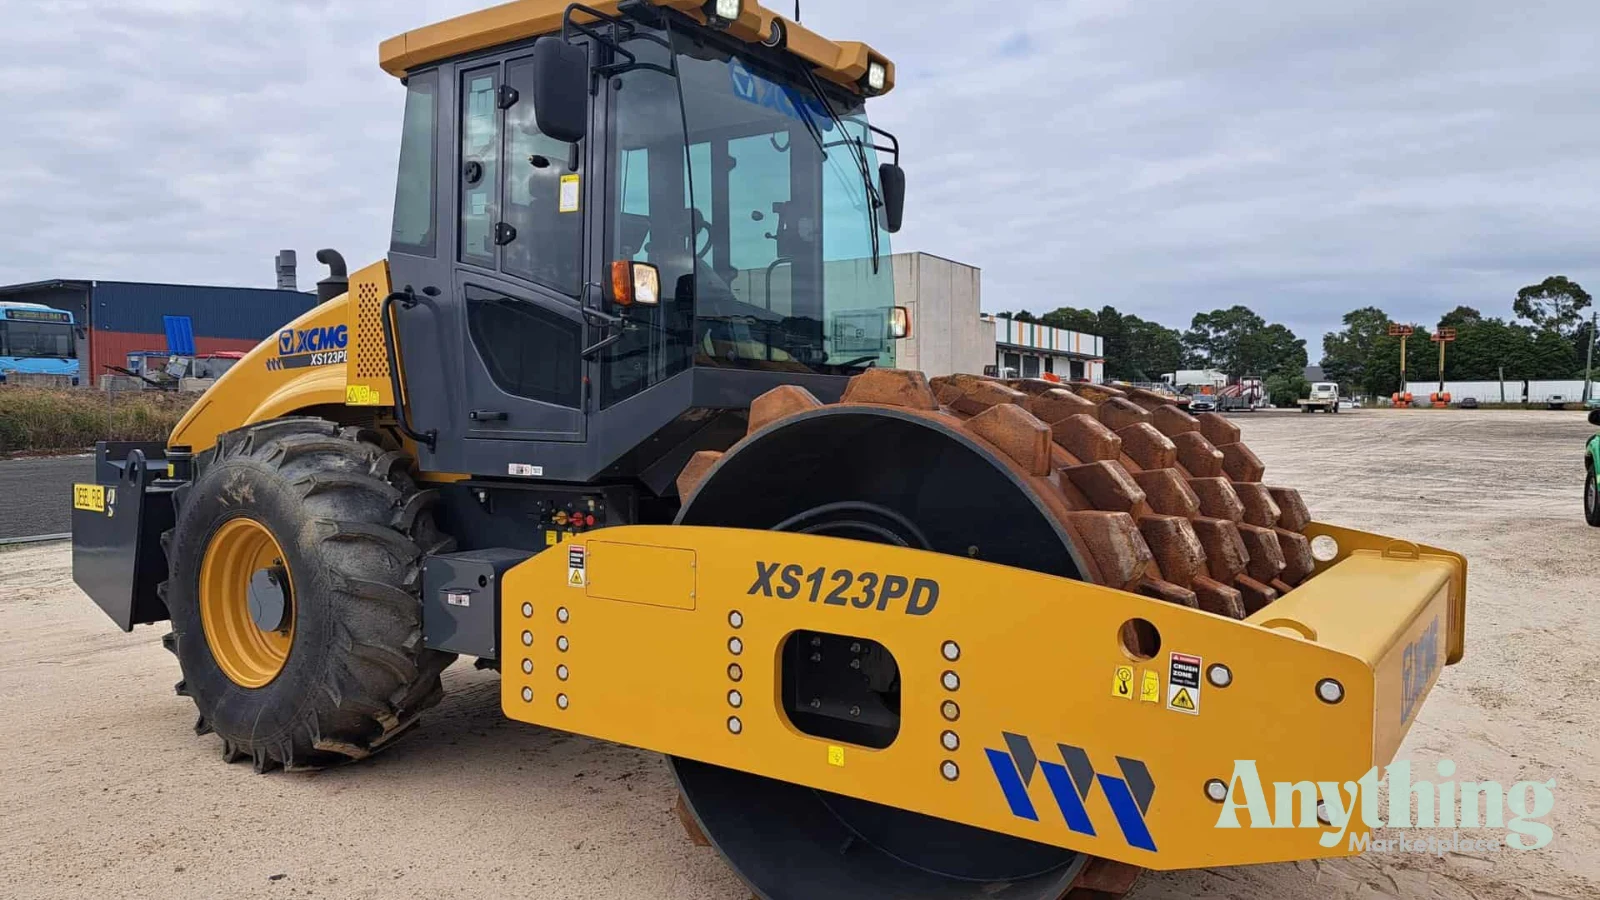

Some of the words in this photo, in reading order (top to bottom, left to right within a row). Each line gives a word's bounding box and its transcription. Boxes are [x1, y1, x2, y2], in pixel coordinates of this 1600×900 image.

[297, 324, 348, 353] XCMG
[747, 561, 940, 616] XS123PD
[1173, 663, 1198, 672] CRUSH
[1173, 670, 1193, 679] ZONE
